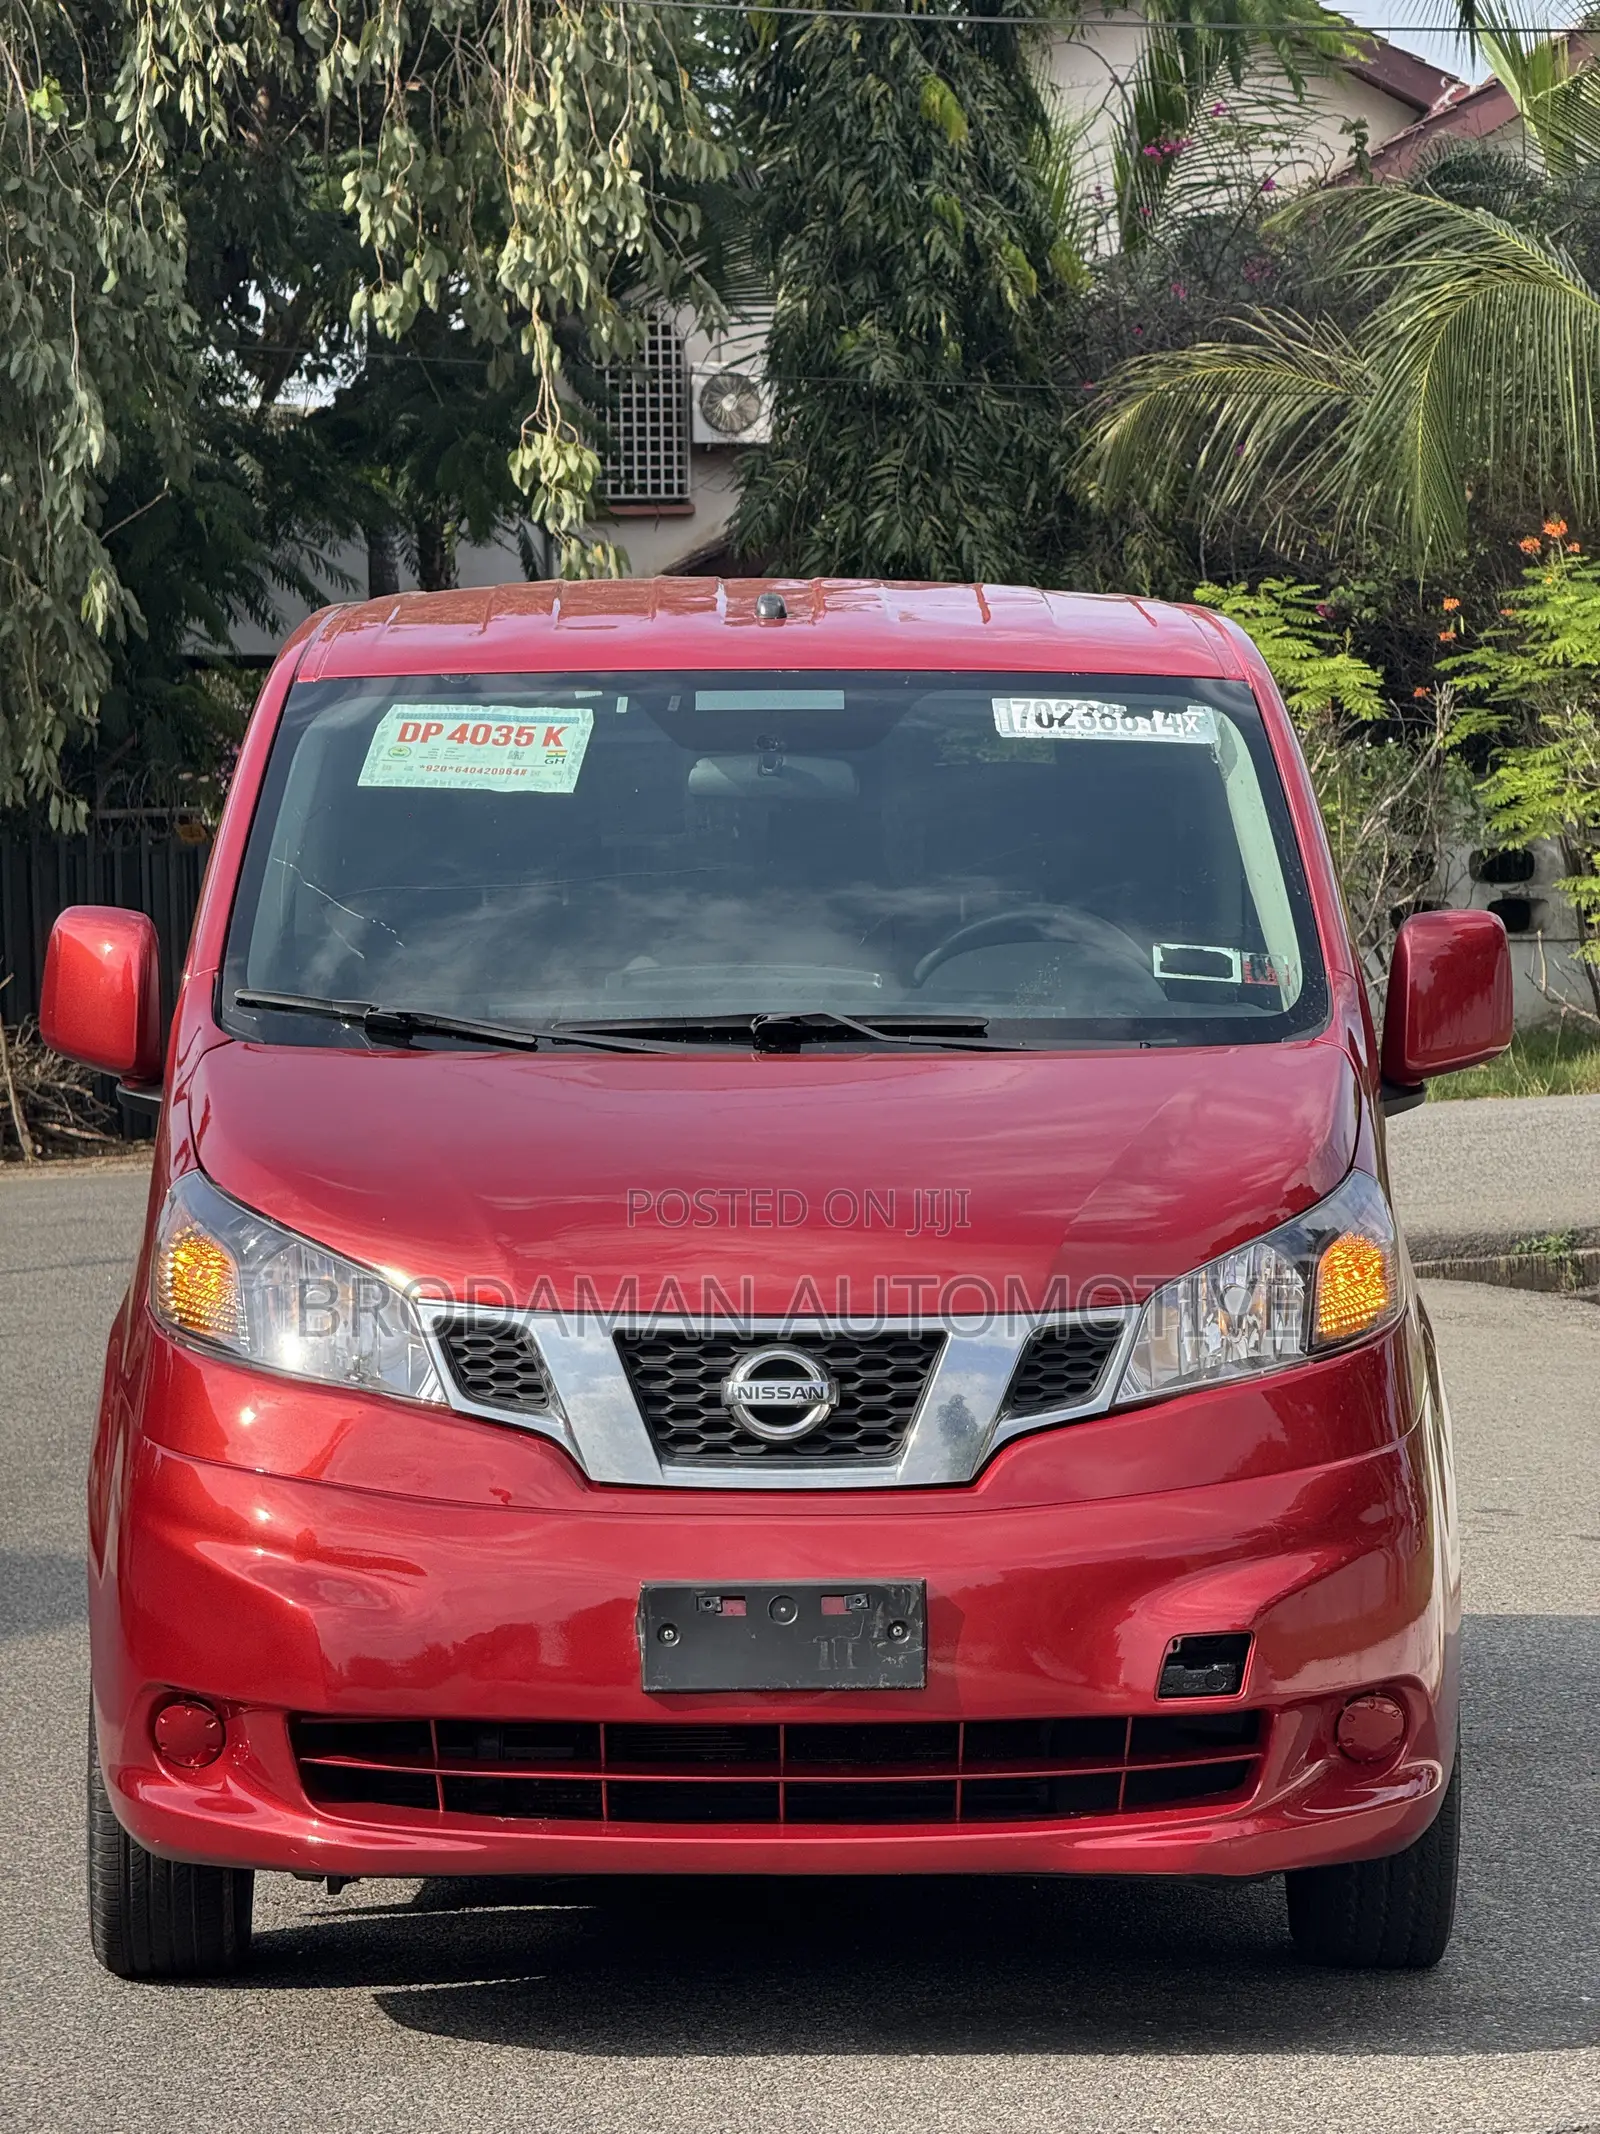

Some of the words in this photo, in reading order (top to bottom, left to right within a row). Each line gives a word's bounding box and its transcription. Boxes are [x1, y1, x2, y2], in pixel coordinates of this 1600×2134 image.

[396, 721, 444, 744] DP
[446, 723, 536, 747] 4035
[541, 725, 569, 747] K
[737, 1386, 824, 1400] NISSAN
